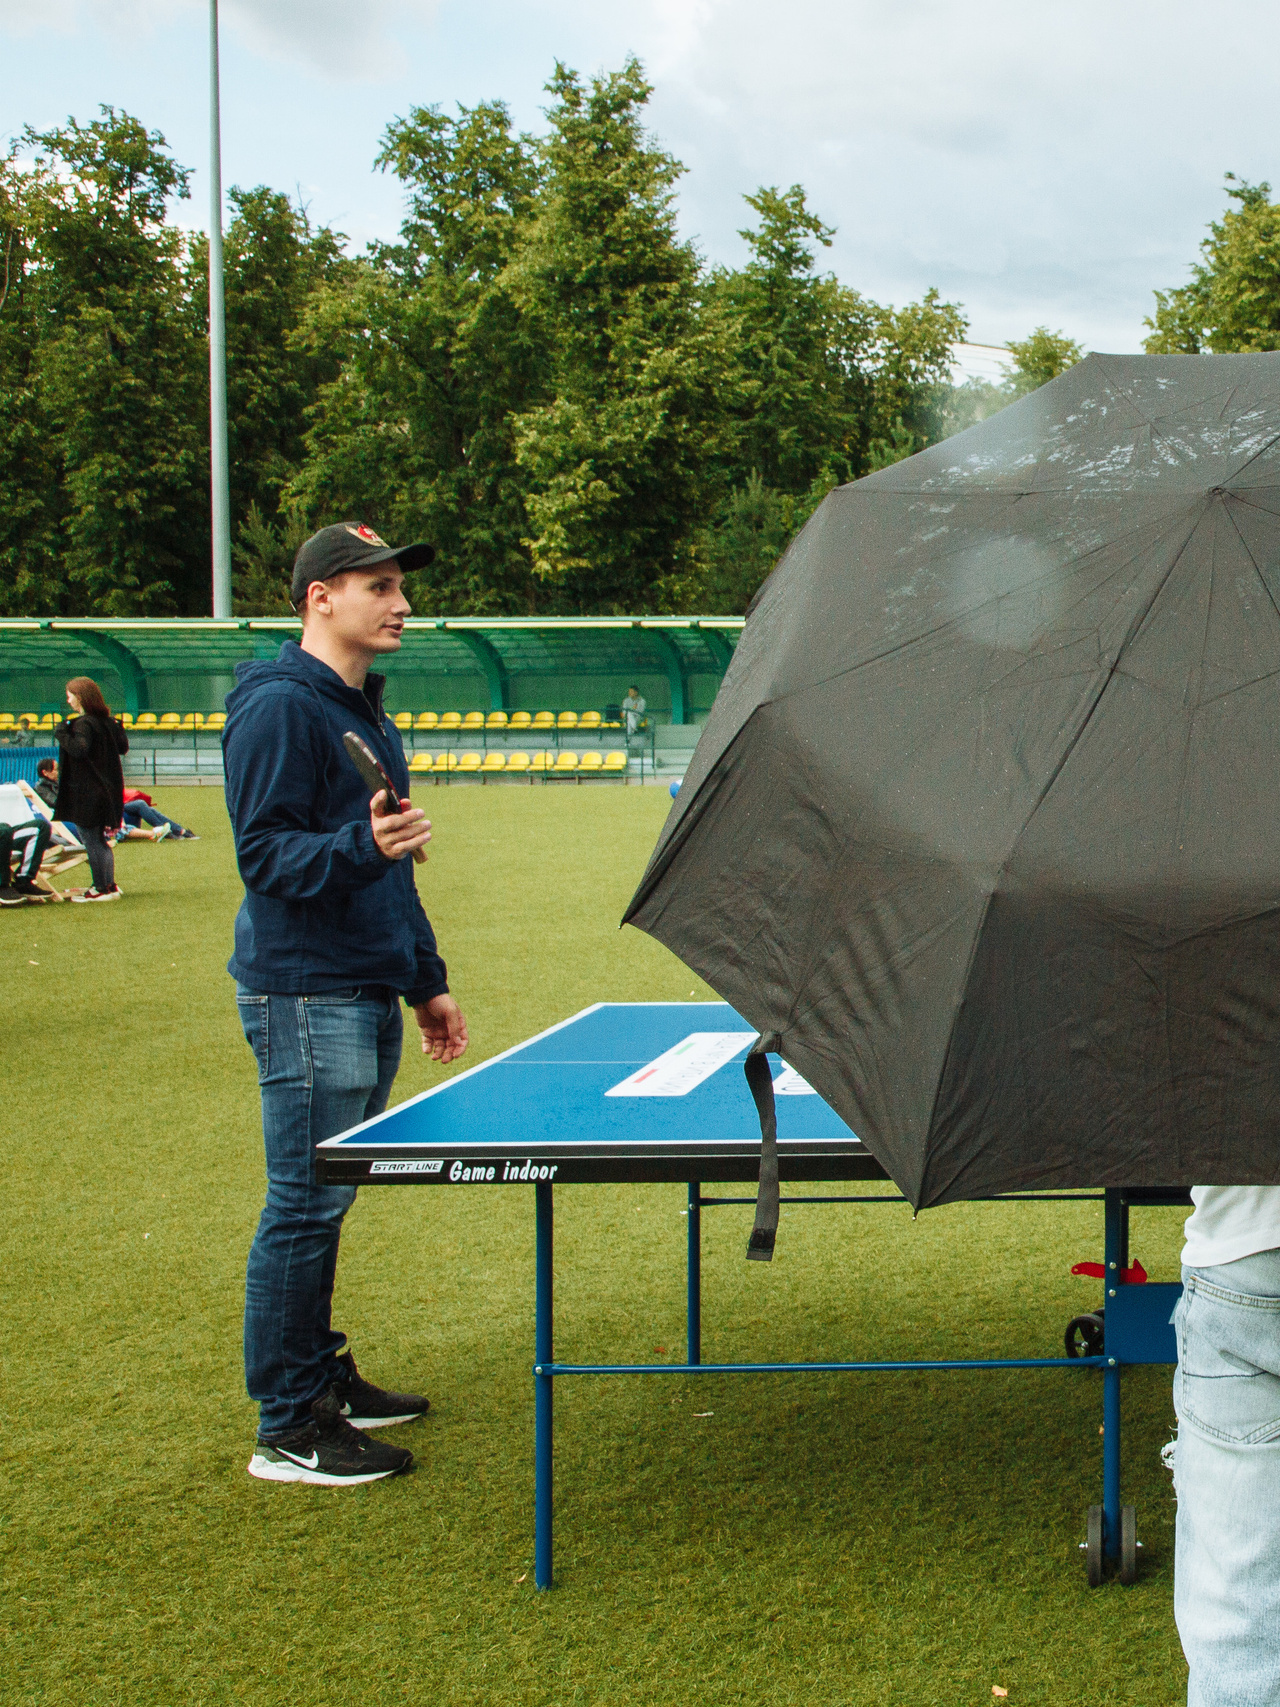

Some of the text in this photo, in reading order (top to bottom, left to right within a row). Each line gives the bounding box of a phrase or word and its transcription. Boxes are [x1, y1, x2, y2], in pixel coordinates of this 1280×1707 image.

[373, 1162, 440, 1171] START LINE
[450, 1159, 558, 1181] Game indoor
